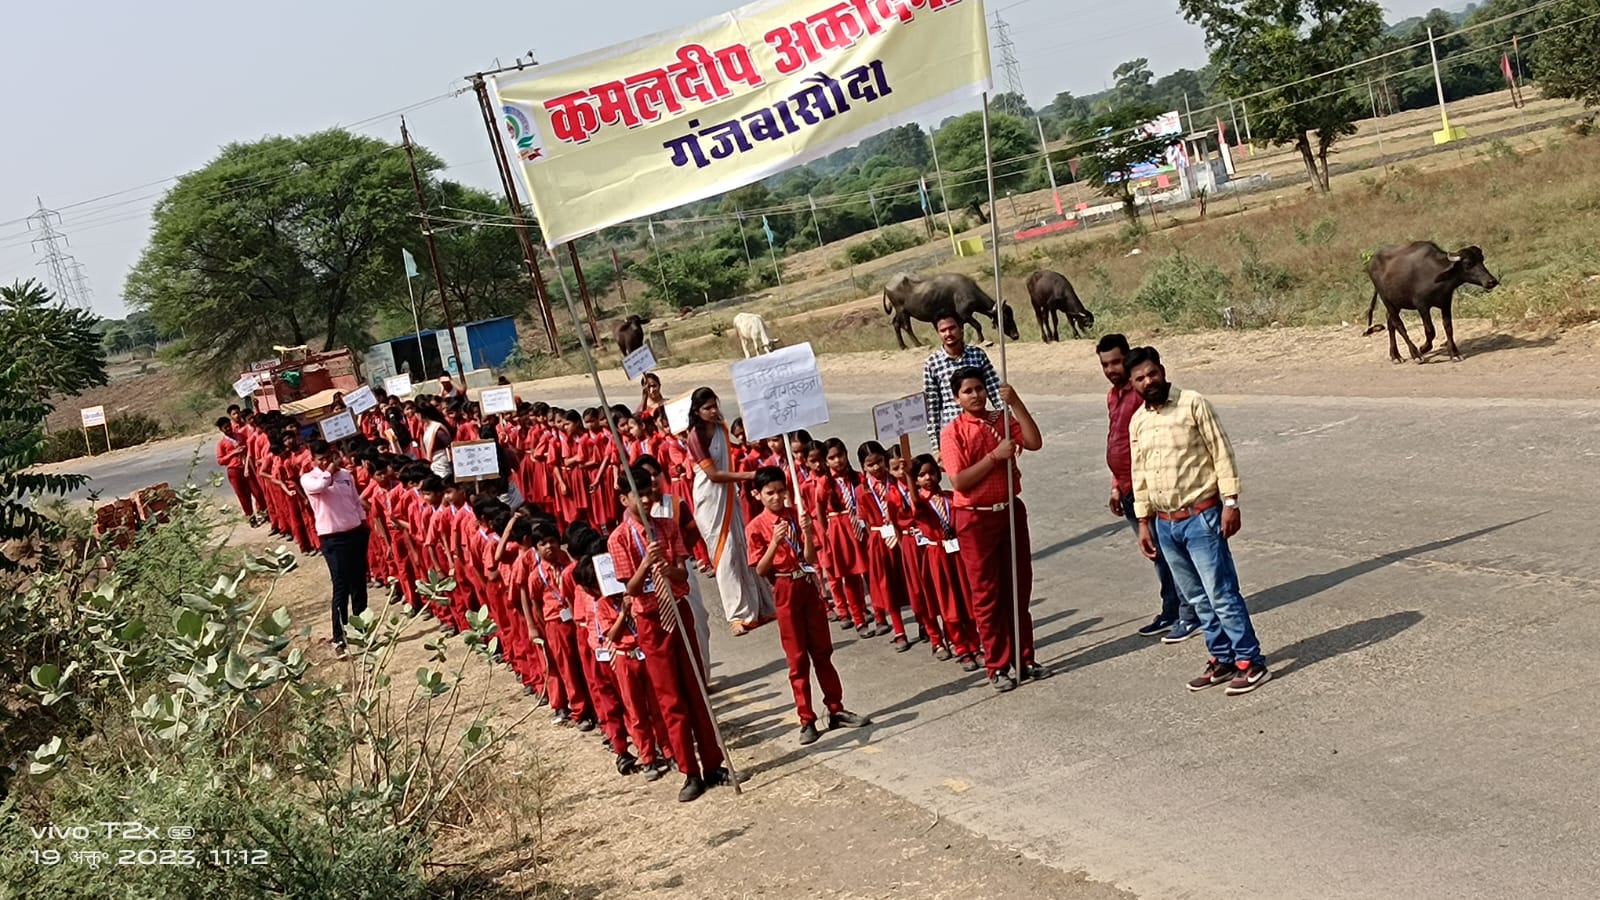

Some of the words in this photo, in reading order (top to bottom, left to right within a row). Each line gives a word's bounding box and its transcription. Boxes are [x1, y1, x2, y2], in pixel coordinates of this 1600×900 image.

[543, 43, 764, 143] कमलदीप
[763, 0, 961, 75] अकाद
[663, 59, 893, 168] गंजबासौदा
